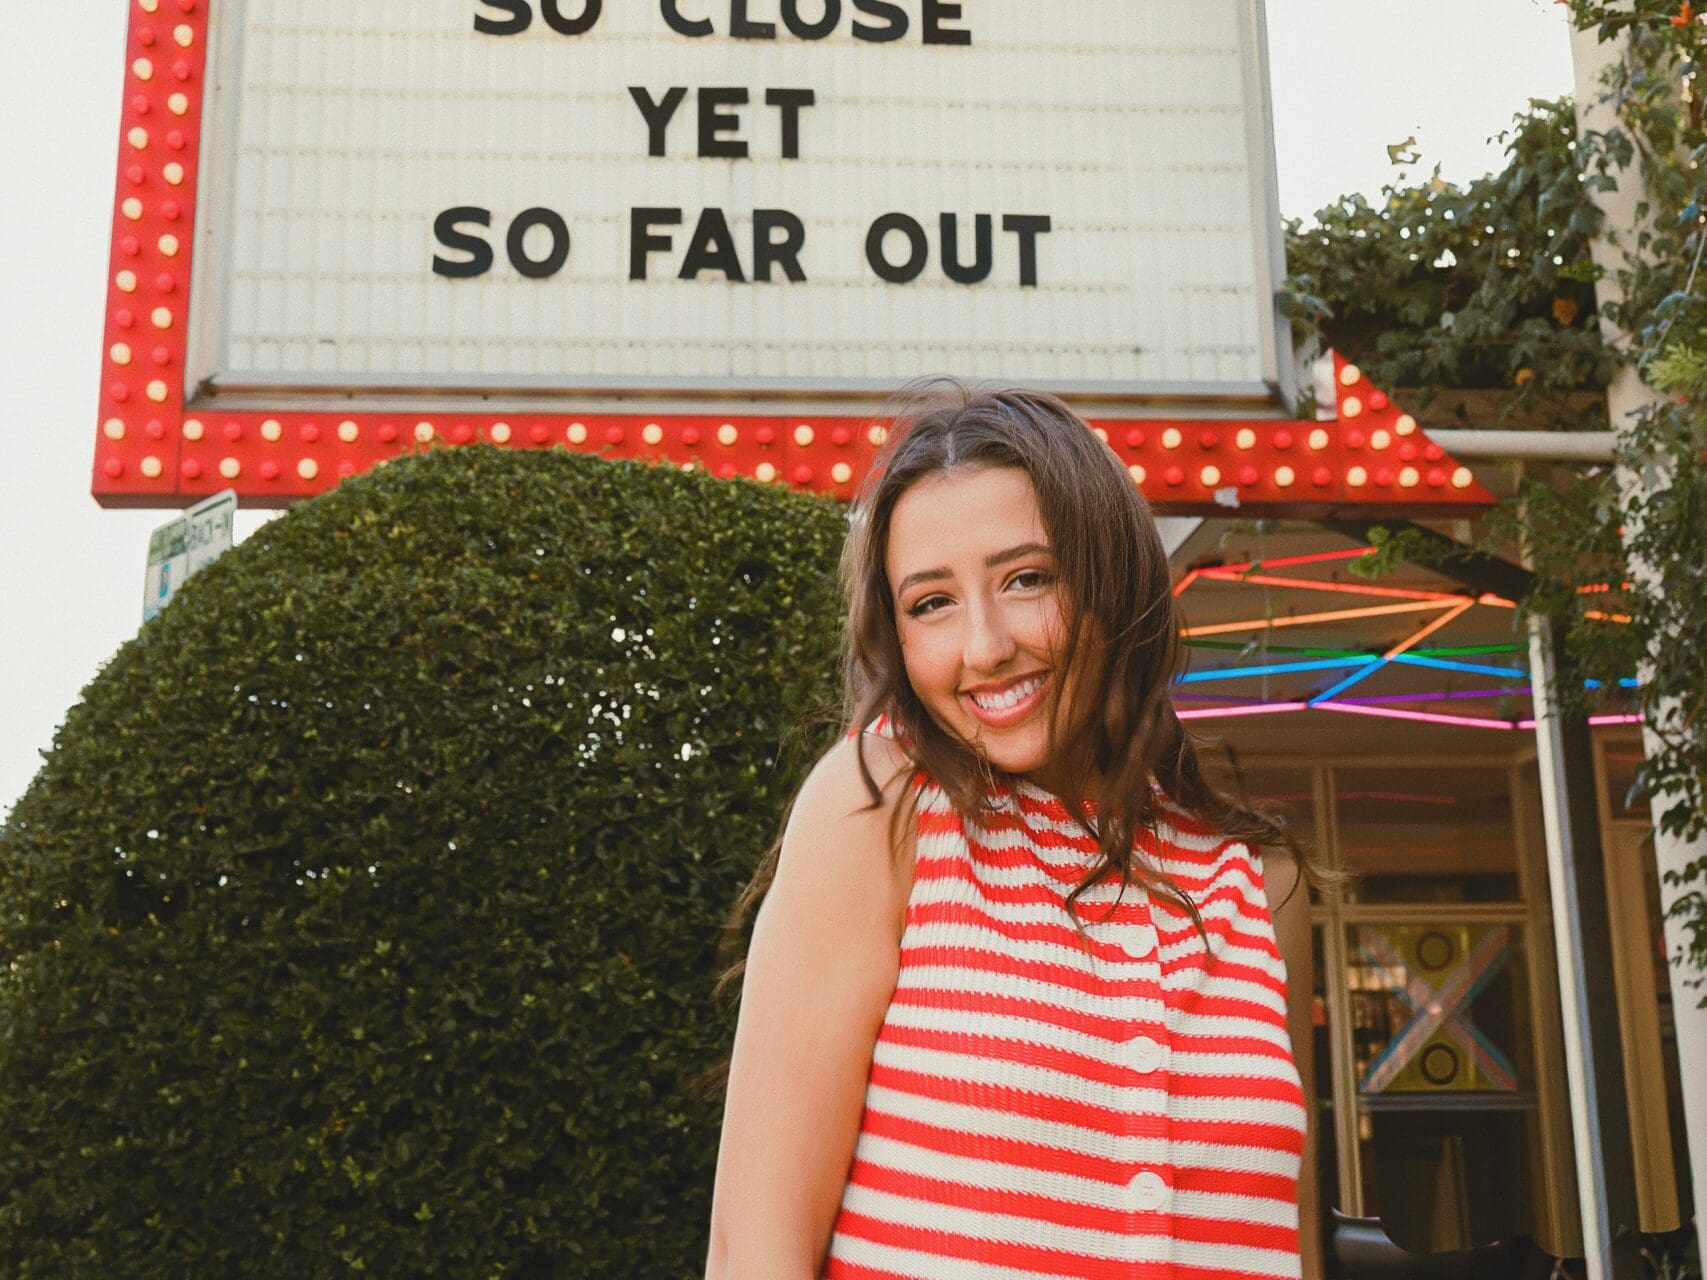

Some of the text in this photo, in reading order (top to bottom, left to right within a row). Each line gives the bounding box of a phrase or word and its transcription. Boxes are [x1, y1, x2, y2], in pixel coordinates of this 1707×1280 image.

[627, 86, 815, 160] YET
[432, 206, 1051, 288] SO FAR OUT
